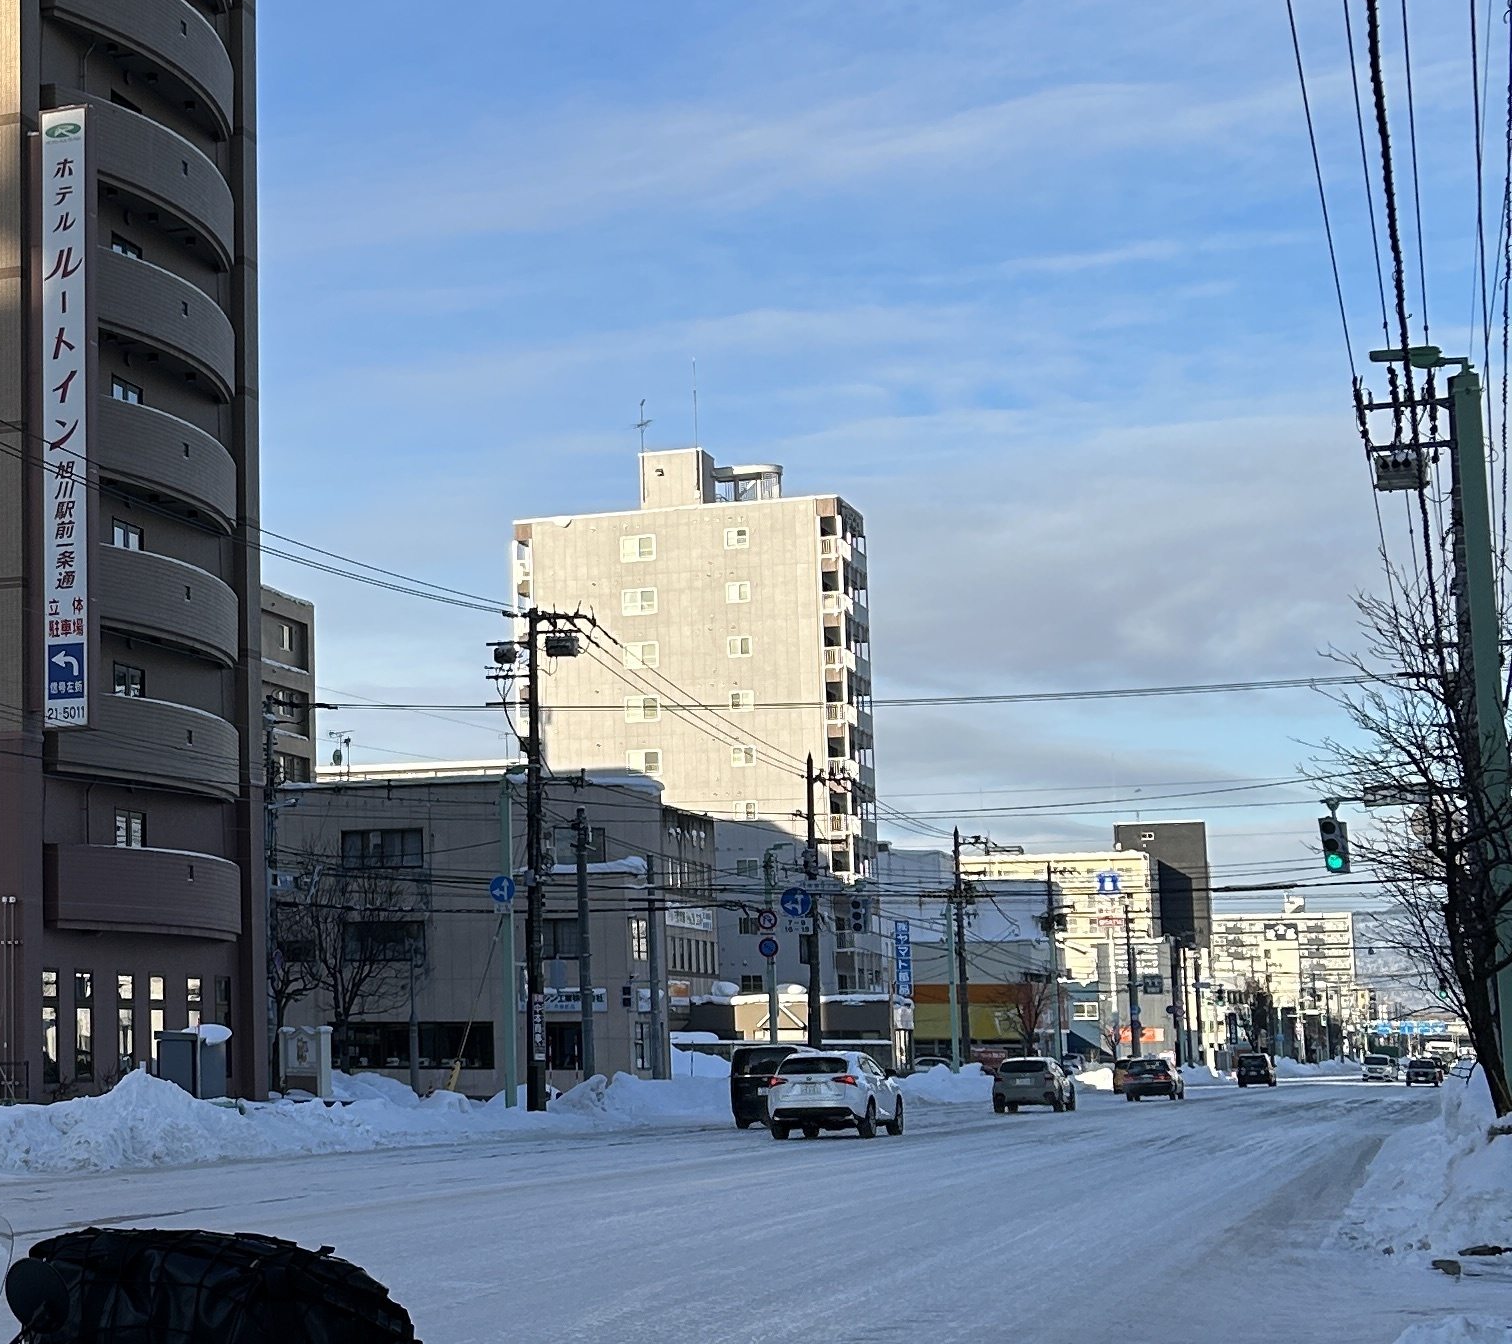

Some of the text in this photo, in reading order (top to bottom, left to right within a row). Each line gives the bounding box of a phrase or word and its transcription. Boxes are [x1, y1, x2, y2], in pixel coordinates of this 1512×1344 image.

[53, 158, 77, 233] ホテル
[44, 247, 83, 451] ルートイン
[54, 461, 77, 590] 旭川駅前一条通
[49, 597, 84, 617] 立体
[49, 618, 84, 638] 駐車場
